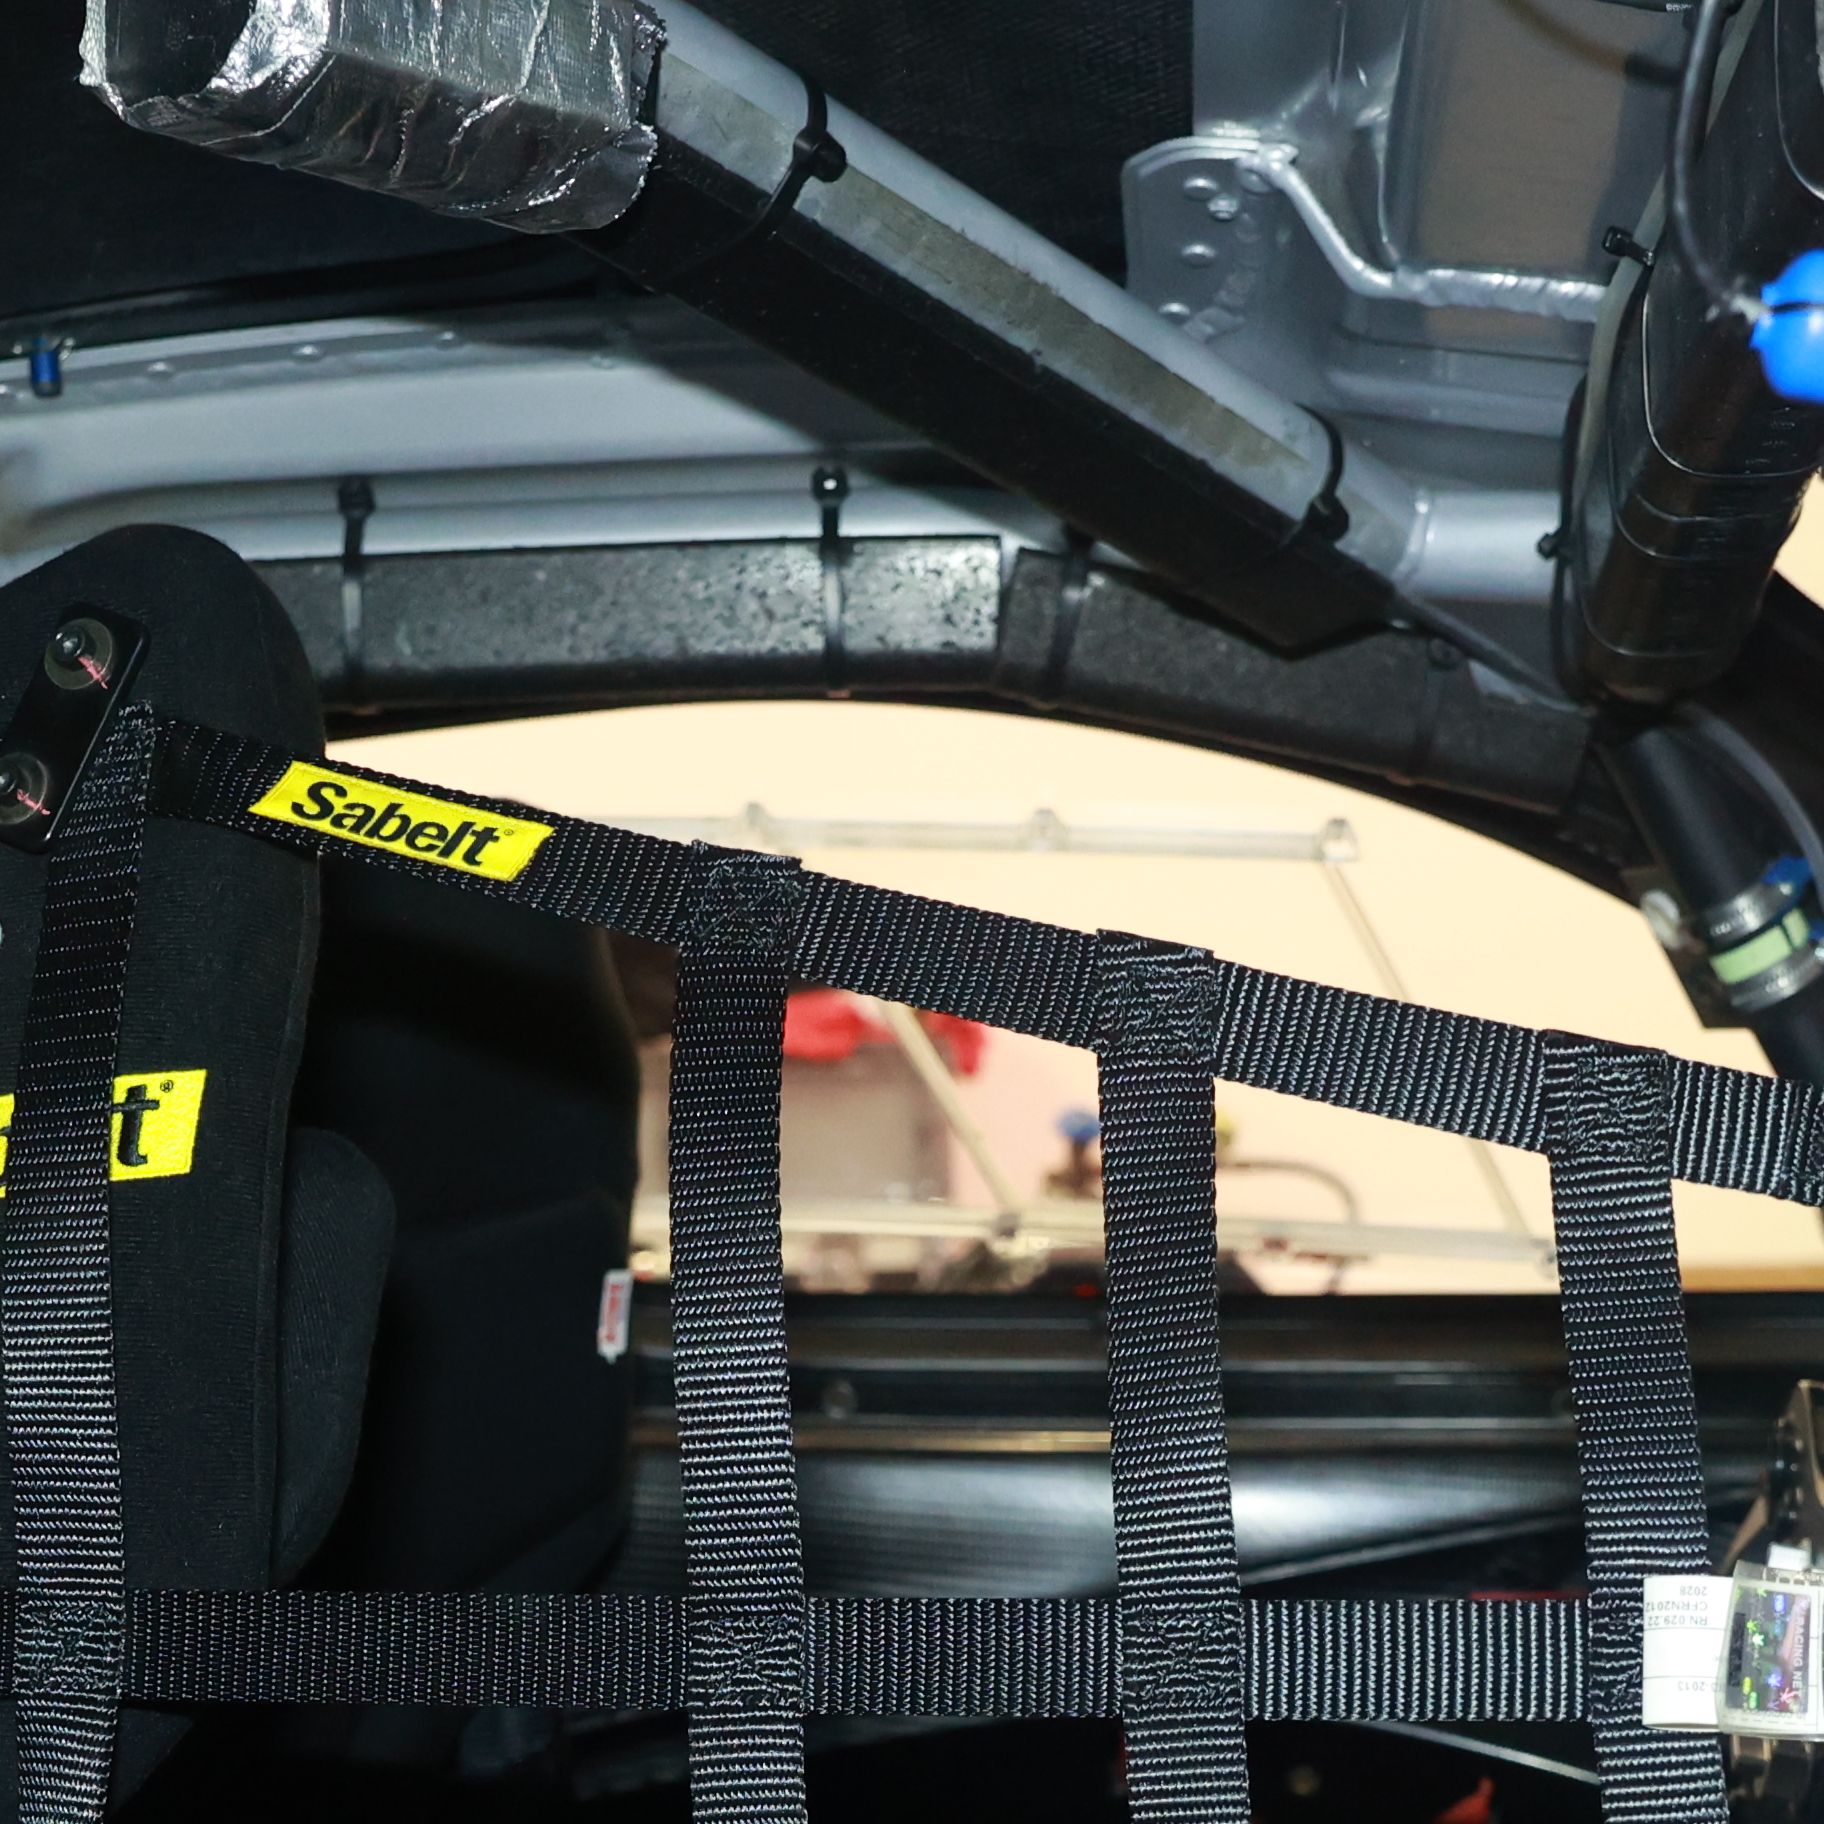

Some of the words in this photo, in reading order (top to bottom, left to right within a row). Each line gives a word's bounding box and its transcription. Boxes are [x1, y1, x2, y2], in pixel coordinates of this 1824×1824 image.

[291, 781, 503, 868] Sabelt
[1679, 1585, 1708, 1597] 2028
[1792, 1616, 1805, 1667] RACING
